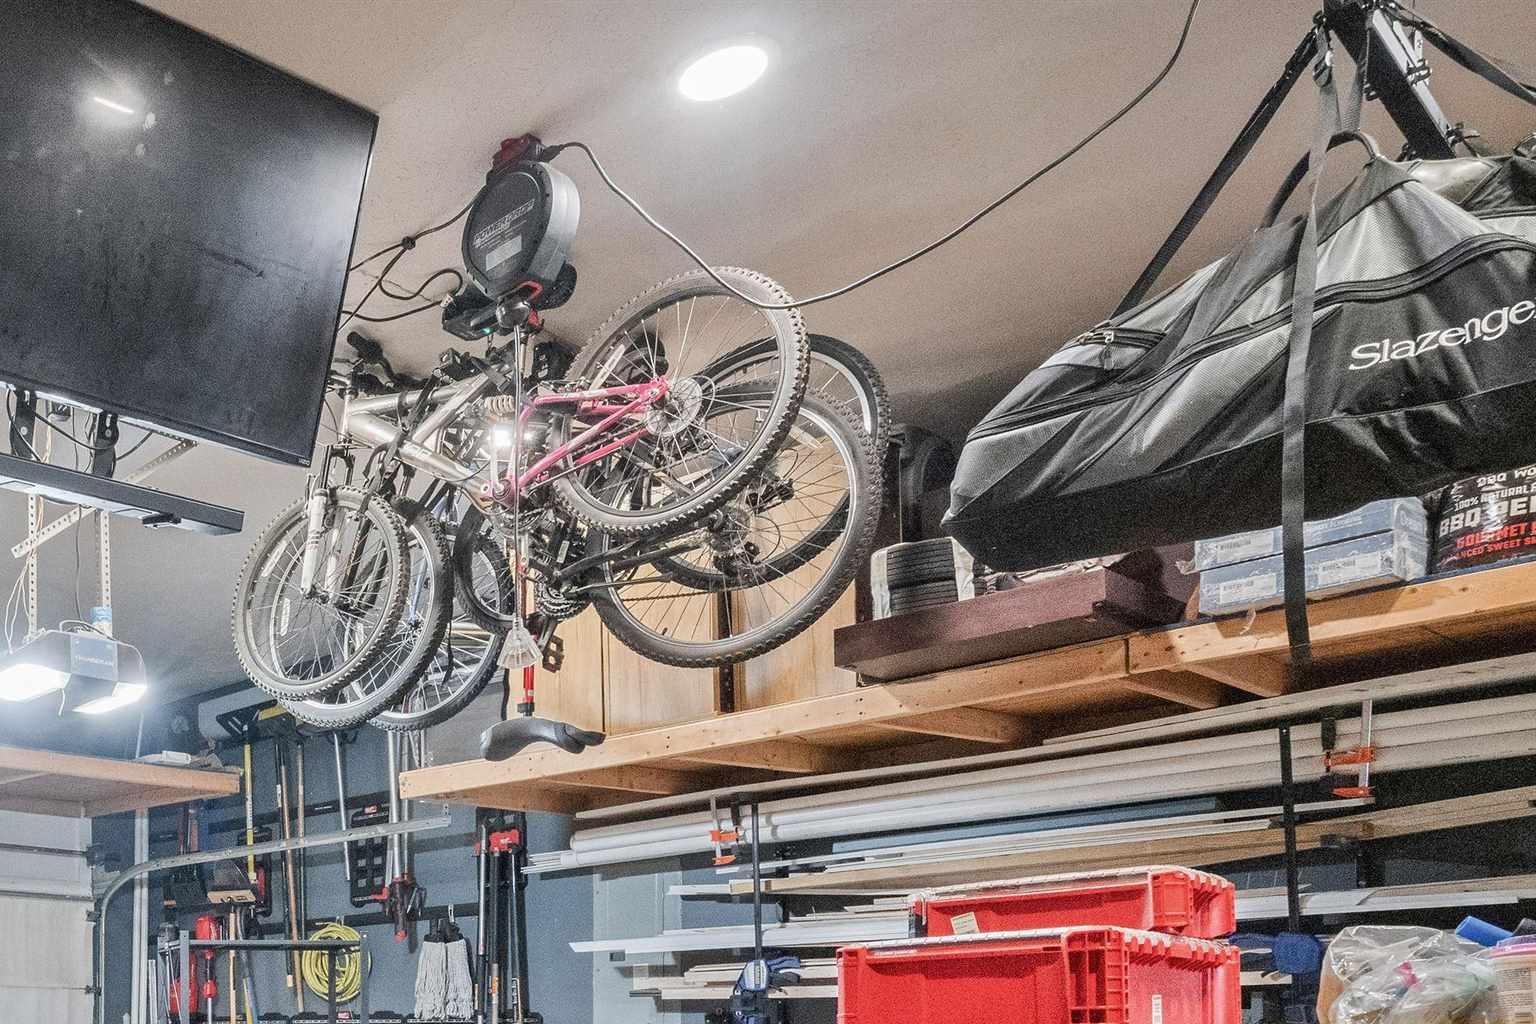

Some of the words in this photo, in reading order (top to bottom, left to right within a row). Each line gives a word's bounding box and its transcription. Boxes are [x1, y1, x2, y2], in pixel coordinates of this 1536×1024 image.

[1348, 300, 1536, 371] Slazenge
[1439, 507, 1481, 538] BBQ
[1487, 538, 1521, 553] SWEET
